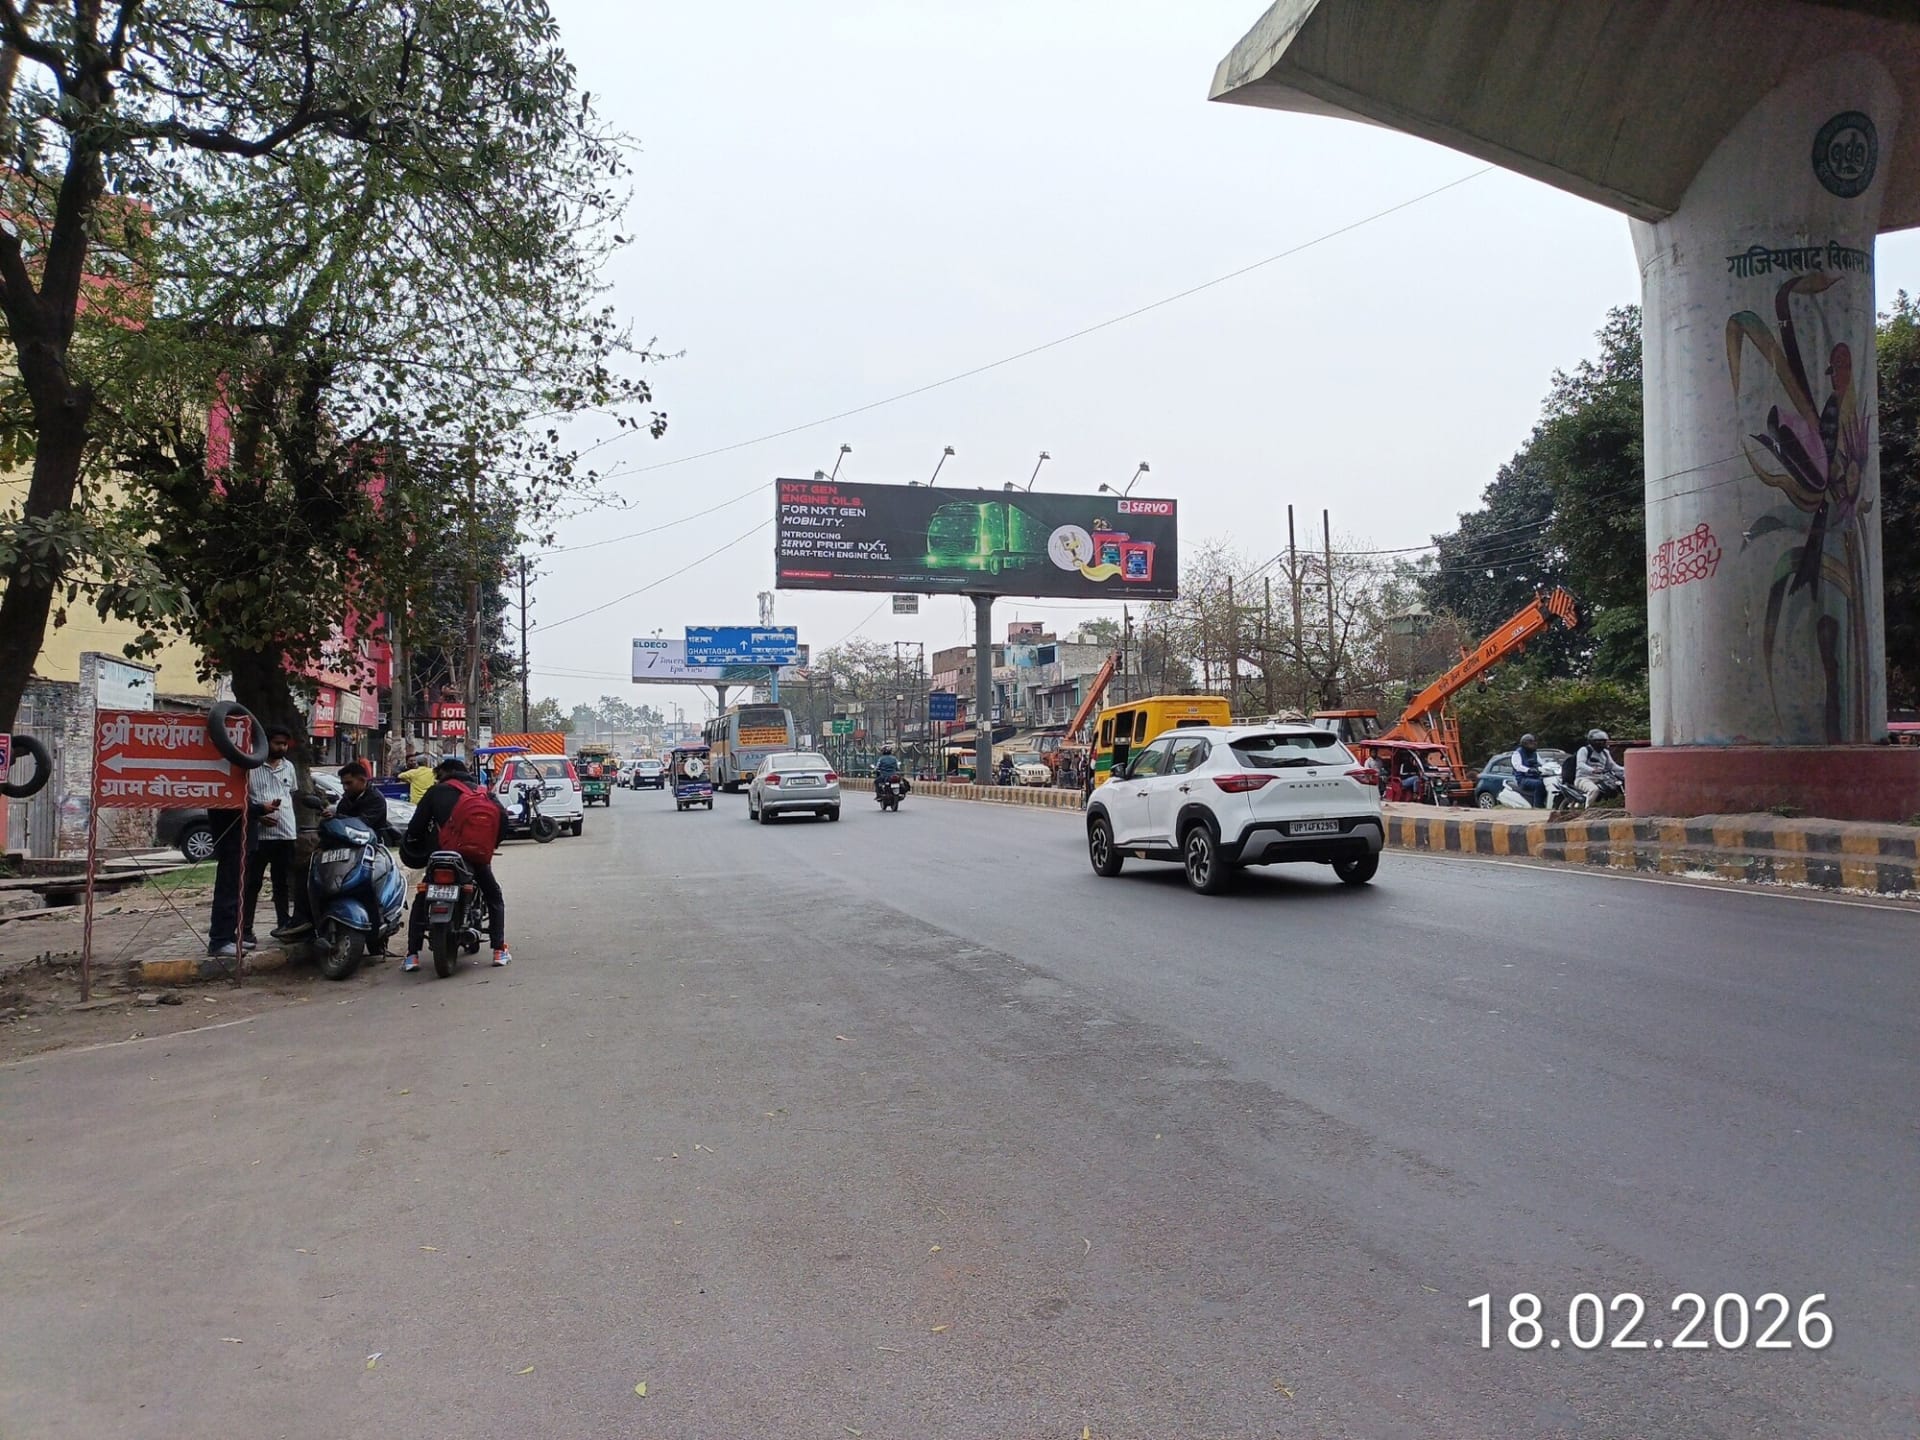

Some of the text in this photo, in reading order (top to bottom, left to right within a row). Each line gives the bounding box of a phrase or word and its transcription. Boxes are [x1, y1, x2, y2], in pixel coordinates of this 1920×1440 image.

[1725, 244, 1823, 278] गाजियाबाद
[781, 483, 837, 495] NXT GEN
[781, 494, 829, 505] ENGINE
[781, 505, 866, 517] FOR NXT GEN
[1131, 502, 1168, 514] SERVO
[782, 516, 845, 527] MOBILITY.
[781, 530, 841, 540] INTRODUCING
[781, 540, 812, 549] SERVO
[816, 541, 854, 550] PRIDE
[781, 549, 892, 560] SMART-TECH ENGINE OILS.
[688, 647, 737, 655] GHANTAGHAR
[646, 651, 659, 668] 7
[101, 715, 133, 750] श्री
[101, 779, 146, 797] ग्राम
